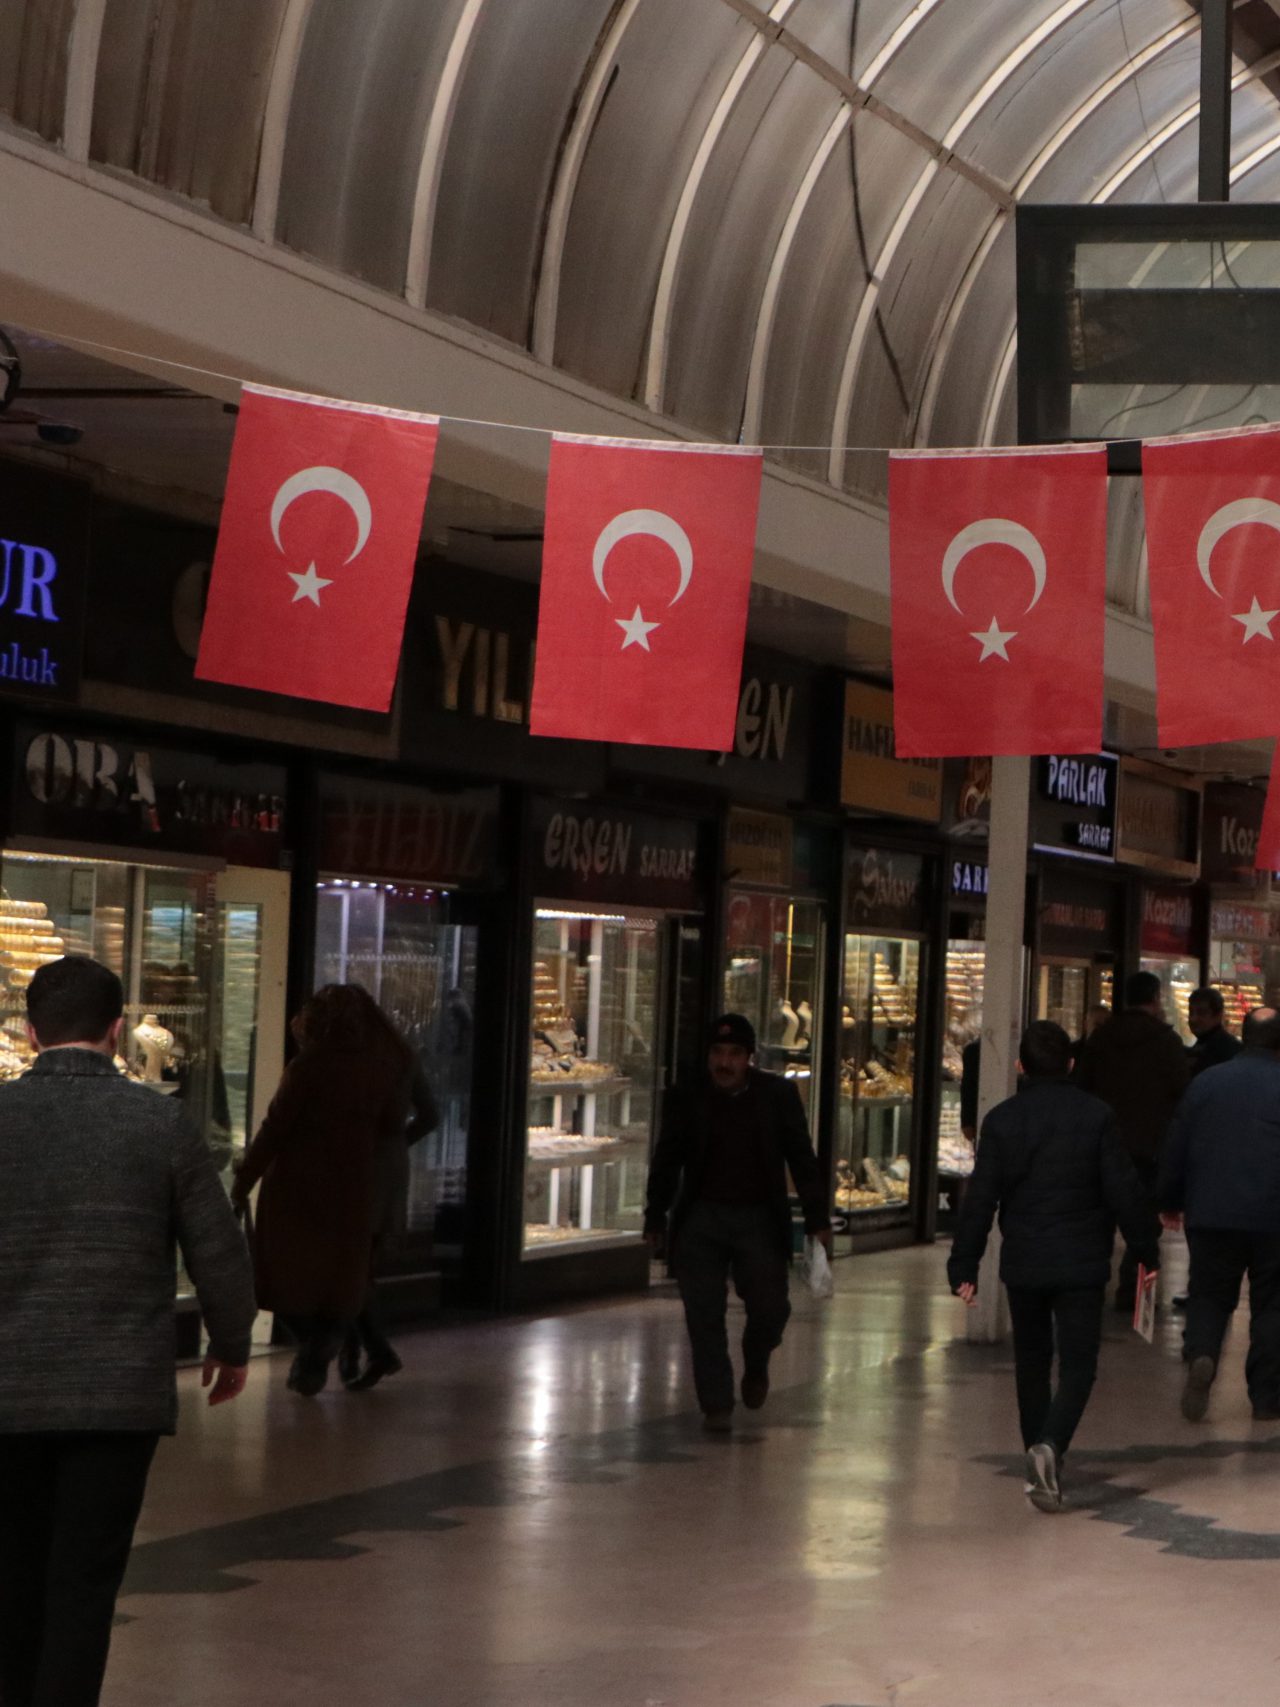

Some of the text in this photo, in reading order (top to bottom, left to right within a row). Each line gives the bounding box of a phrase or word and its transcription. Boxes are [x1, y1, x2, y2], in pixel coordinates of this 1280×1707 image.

[434, 614, 534, 726] YIL
[1047, 755, 1107, 807] PARLAK
[543, 813, 632, 882] ERŞEN
[1078, 821, 1111, 850] SARRAF
